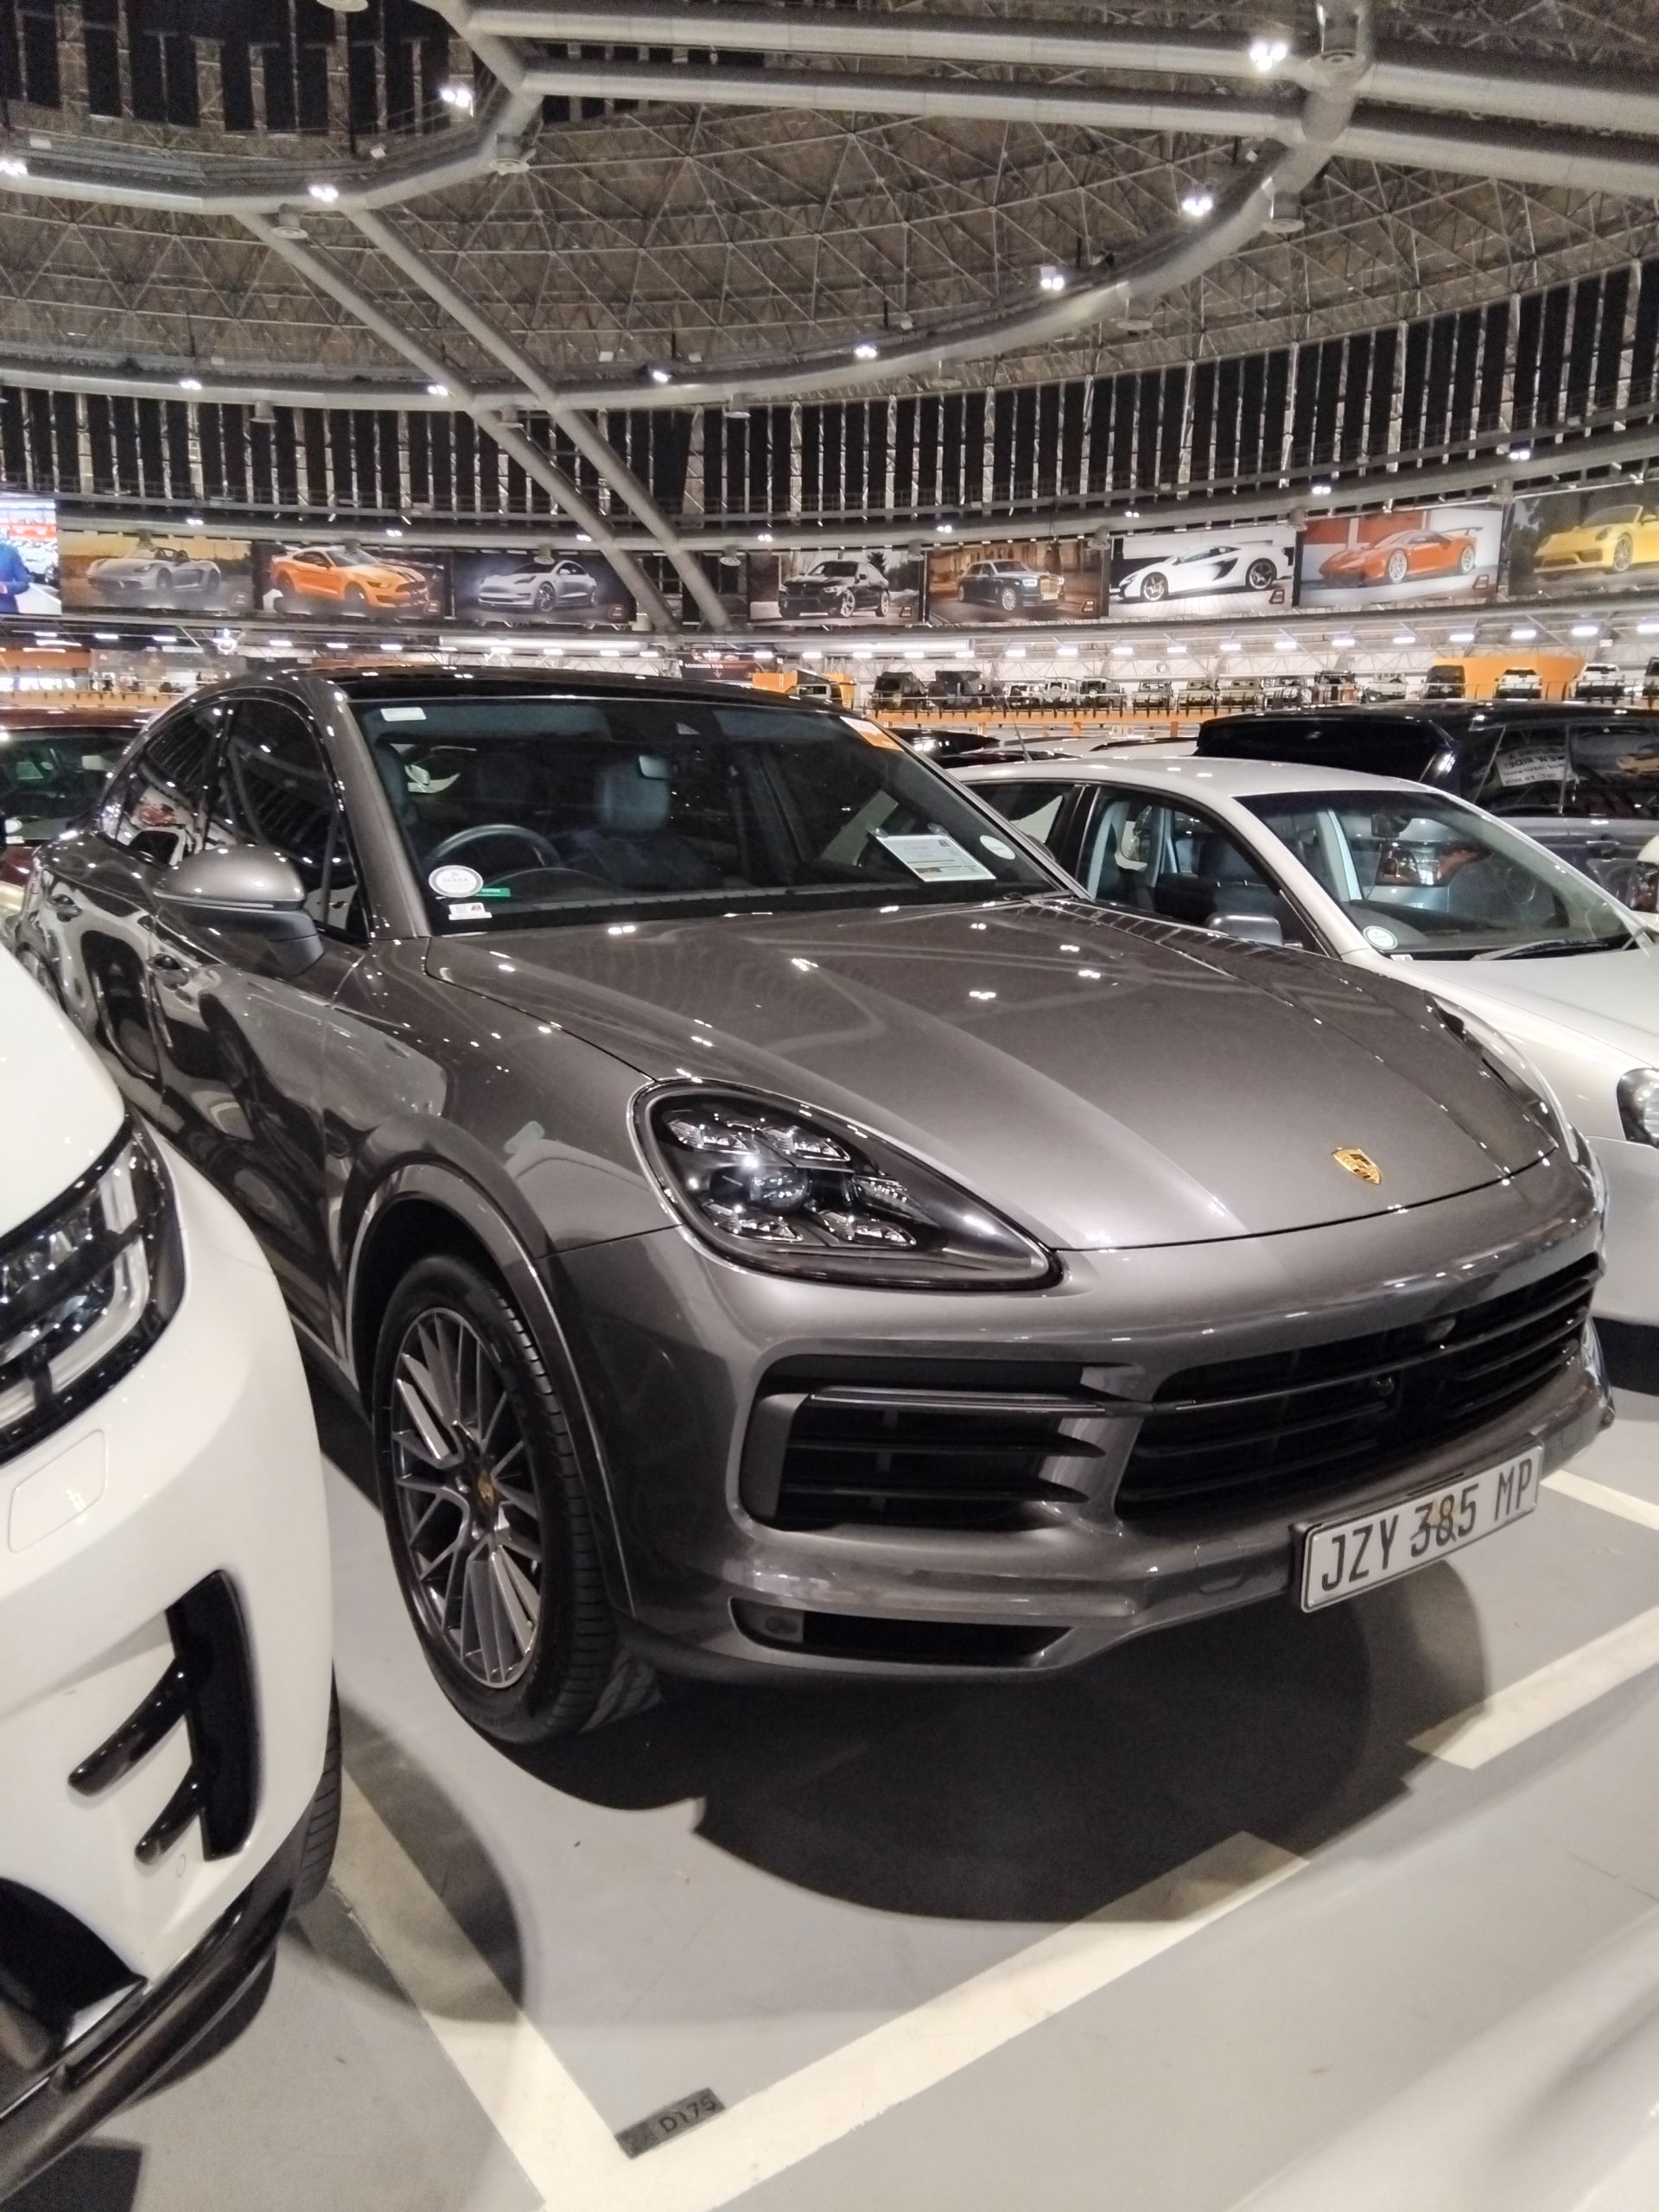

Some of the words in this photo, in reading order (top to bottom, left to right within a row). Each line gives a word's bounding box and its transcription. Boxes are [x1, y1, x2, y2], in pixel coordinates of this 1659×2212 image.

[1321, 1514, 1399, 1592] JZY
[1411, 1483, 1479, 1558] 385
[1495, 1458, 1532, 1521] MP
